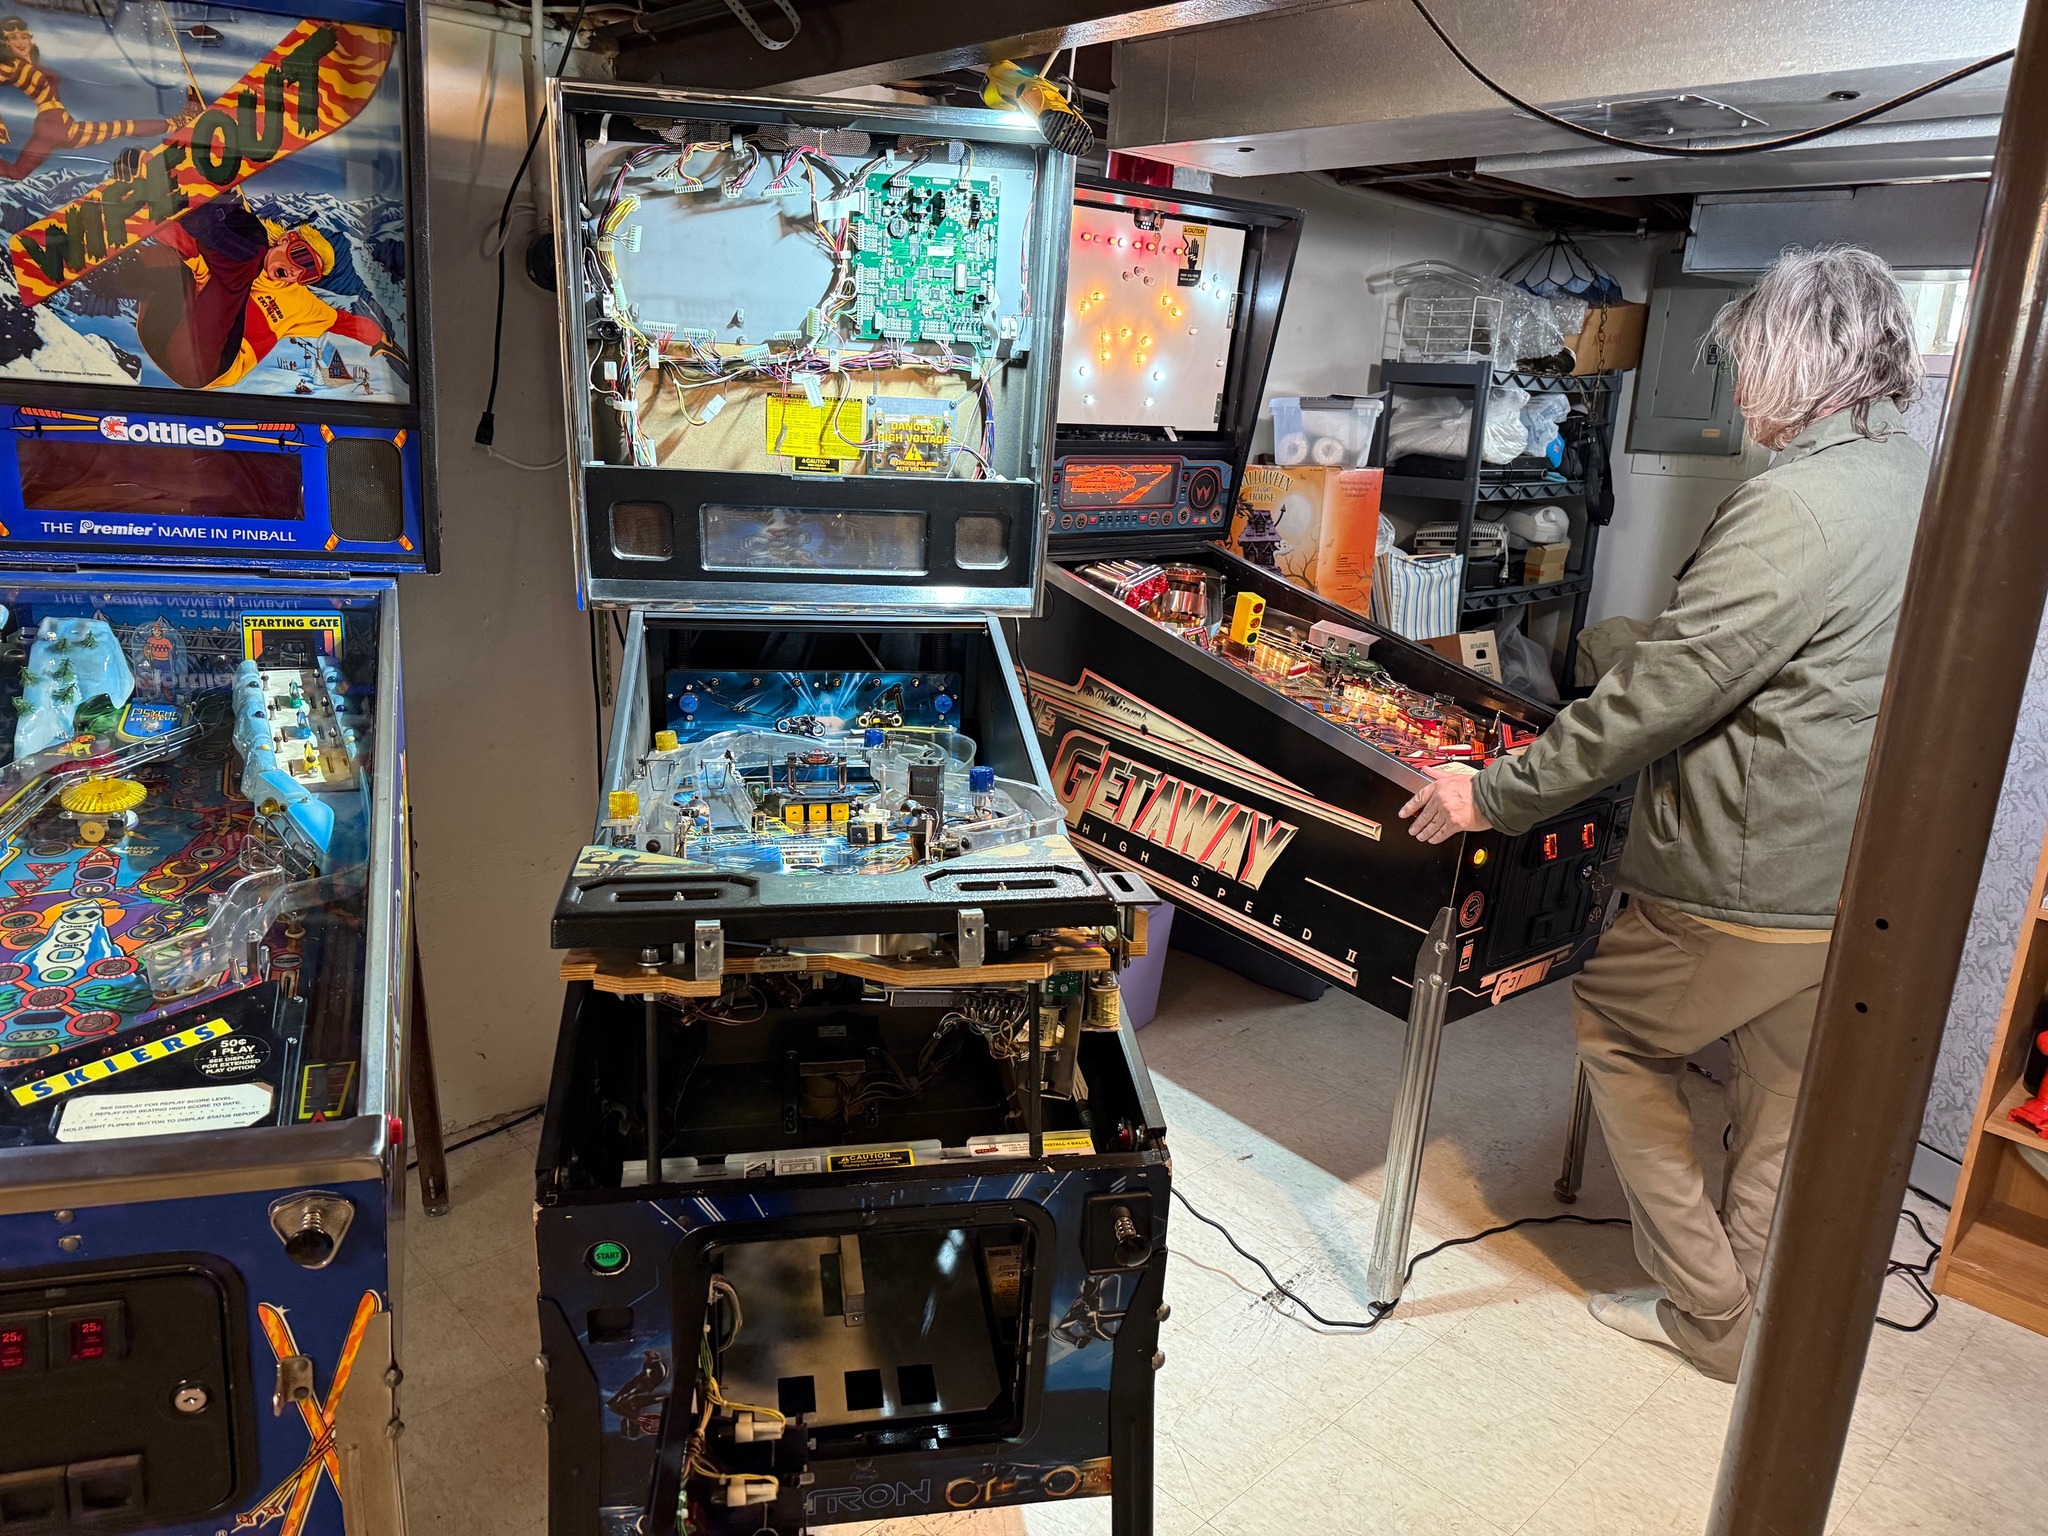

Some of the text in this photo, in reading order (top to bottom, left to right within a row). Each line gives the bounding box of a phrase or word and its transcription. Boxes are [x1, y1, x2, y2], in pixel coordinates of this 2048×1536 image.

[100, 416, 225, 446] Gottlieb
[890, 422, 934, 432] DANGER
[877, 433, 949, 444] HIGH VOLTAGE
[1241, 470, 1294, 493] ALLOWEEN
[1249, 492, 1275, 502] HOUSE
[40, 519, 297, 542] THE Premier NAME IN PINBALL
[180, 609, 241, 619] TO SKI LIF
[244, 617, 340, 628] STARTING GATE
[1050, 729, 1299, 892] GETAWAY
[1082, 822, 1150, 863] HIGH
[1190, 874, 1313, 942] SPEED
[85, 886, 103, 894] 10
[164, 910, 184, 920] 2
[141, 926, 153, 937] 1
[220, 1038, 247, 1048] 50¢
[222, 1044, 256, 1055] PLAY
[31, 1025, 215, 1098] SKIERS
[220, 1058, 261, 1068] EXTENDED
[224, 1054, 255, 1062] DISPLAY
[205, 1064, 256, 1075] PLAY OPTION
[177, 1115, 206, 1123] DISPLAY
[849, 1152, 891, 1161] CAUTION
[595, 1252, 620, 1260] START
[806, 1478, 931, 1516] TRON
